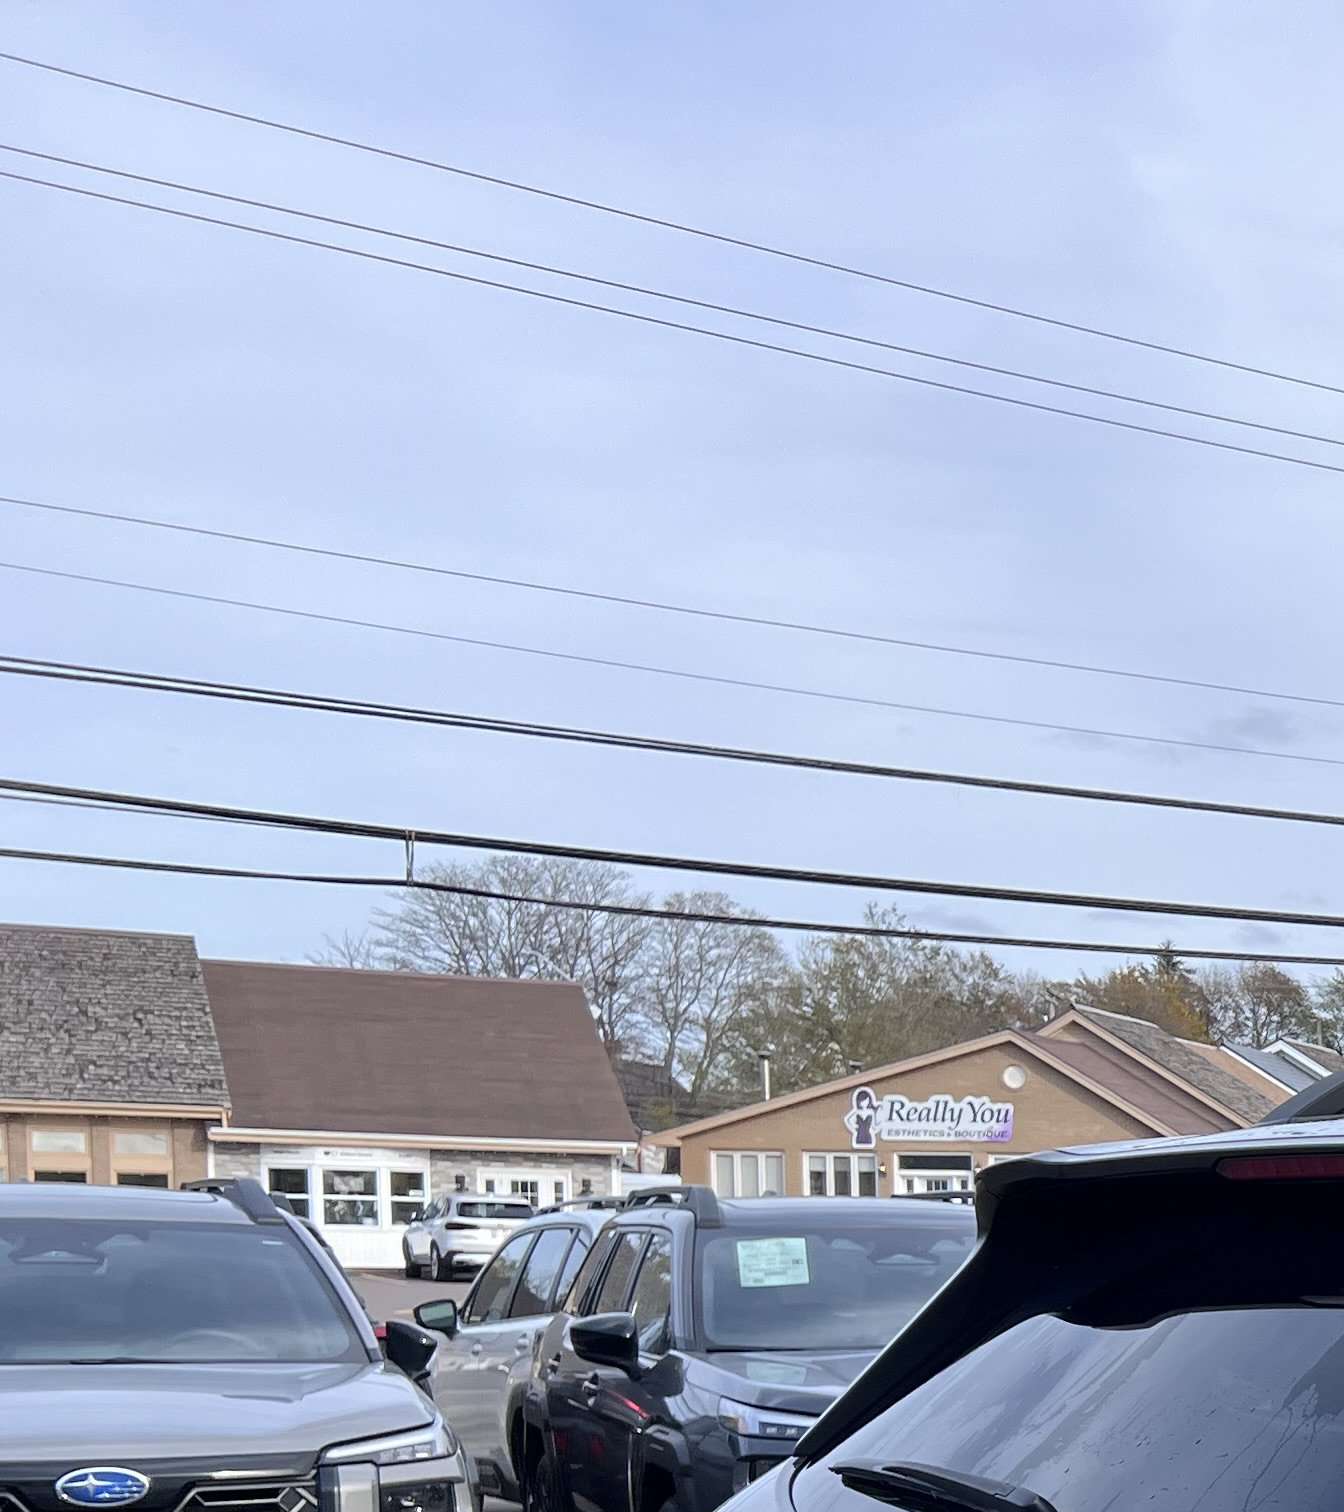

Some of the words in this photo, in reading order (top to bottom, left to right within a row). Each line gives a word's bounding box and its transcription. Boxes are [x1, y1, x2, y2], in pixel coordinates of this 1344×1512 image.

[887, 1100, 963, 1129] Really
[967, 1101, 1010, 1124] You
[887, 1129, 945, 1138] ESTHETICS
[955, 1129, 1008, 1138] BOUTIQUE
